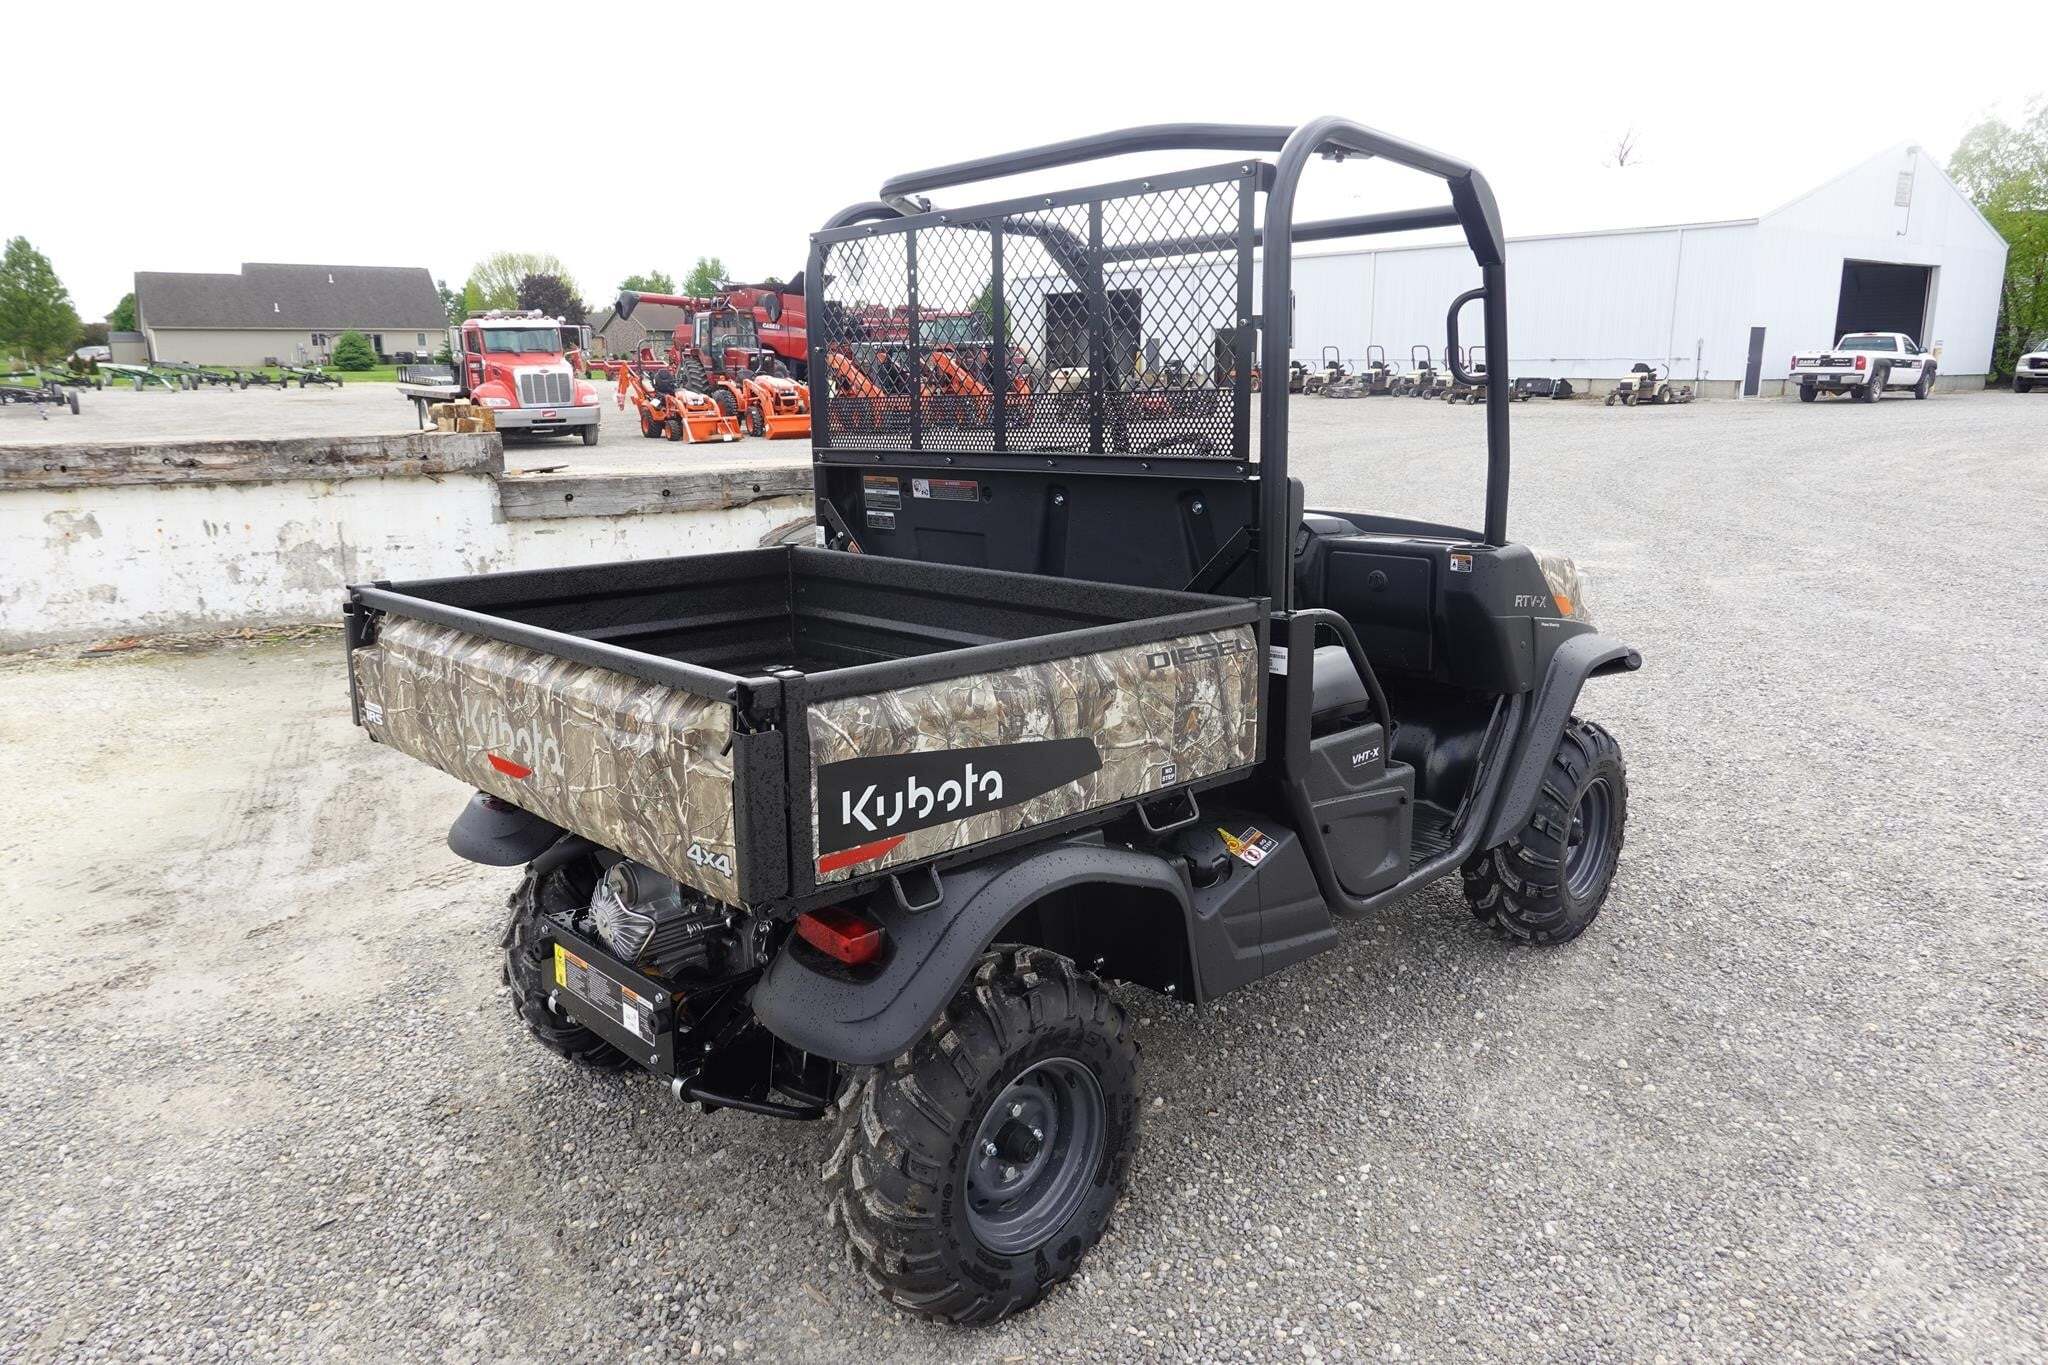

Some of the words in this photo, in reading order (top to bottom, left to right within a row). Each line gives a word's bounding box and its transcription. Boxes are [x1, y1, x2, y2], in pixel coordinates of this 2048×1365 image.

[1514, 594, 1547, 608] RTV-X
[1146, 638, 1254, 670] DIESEL
[464, 694, 566, 790] Kubota
[1352, 746, 1380, 765] VHT-X
[842, 762, 1003, 832] Kubota
[686, 842, 733, 879] 4x4
